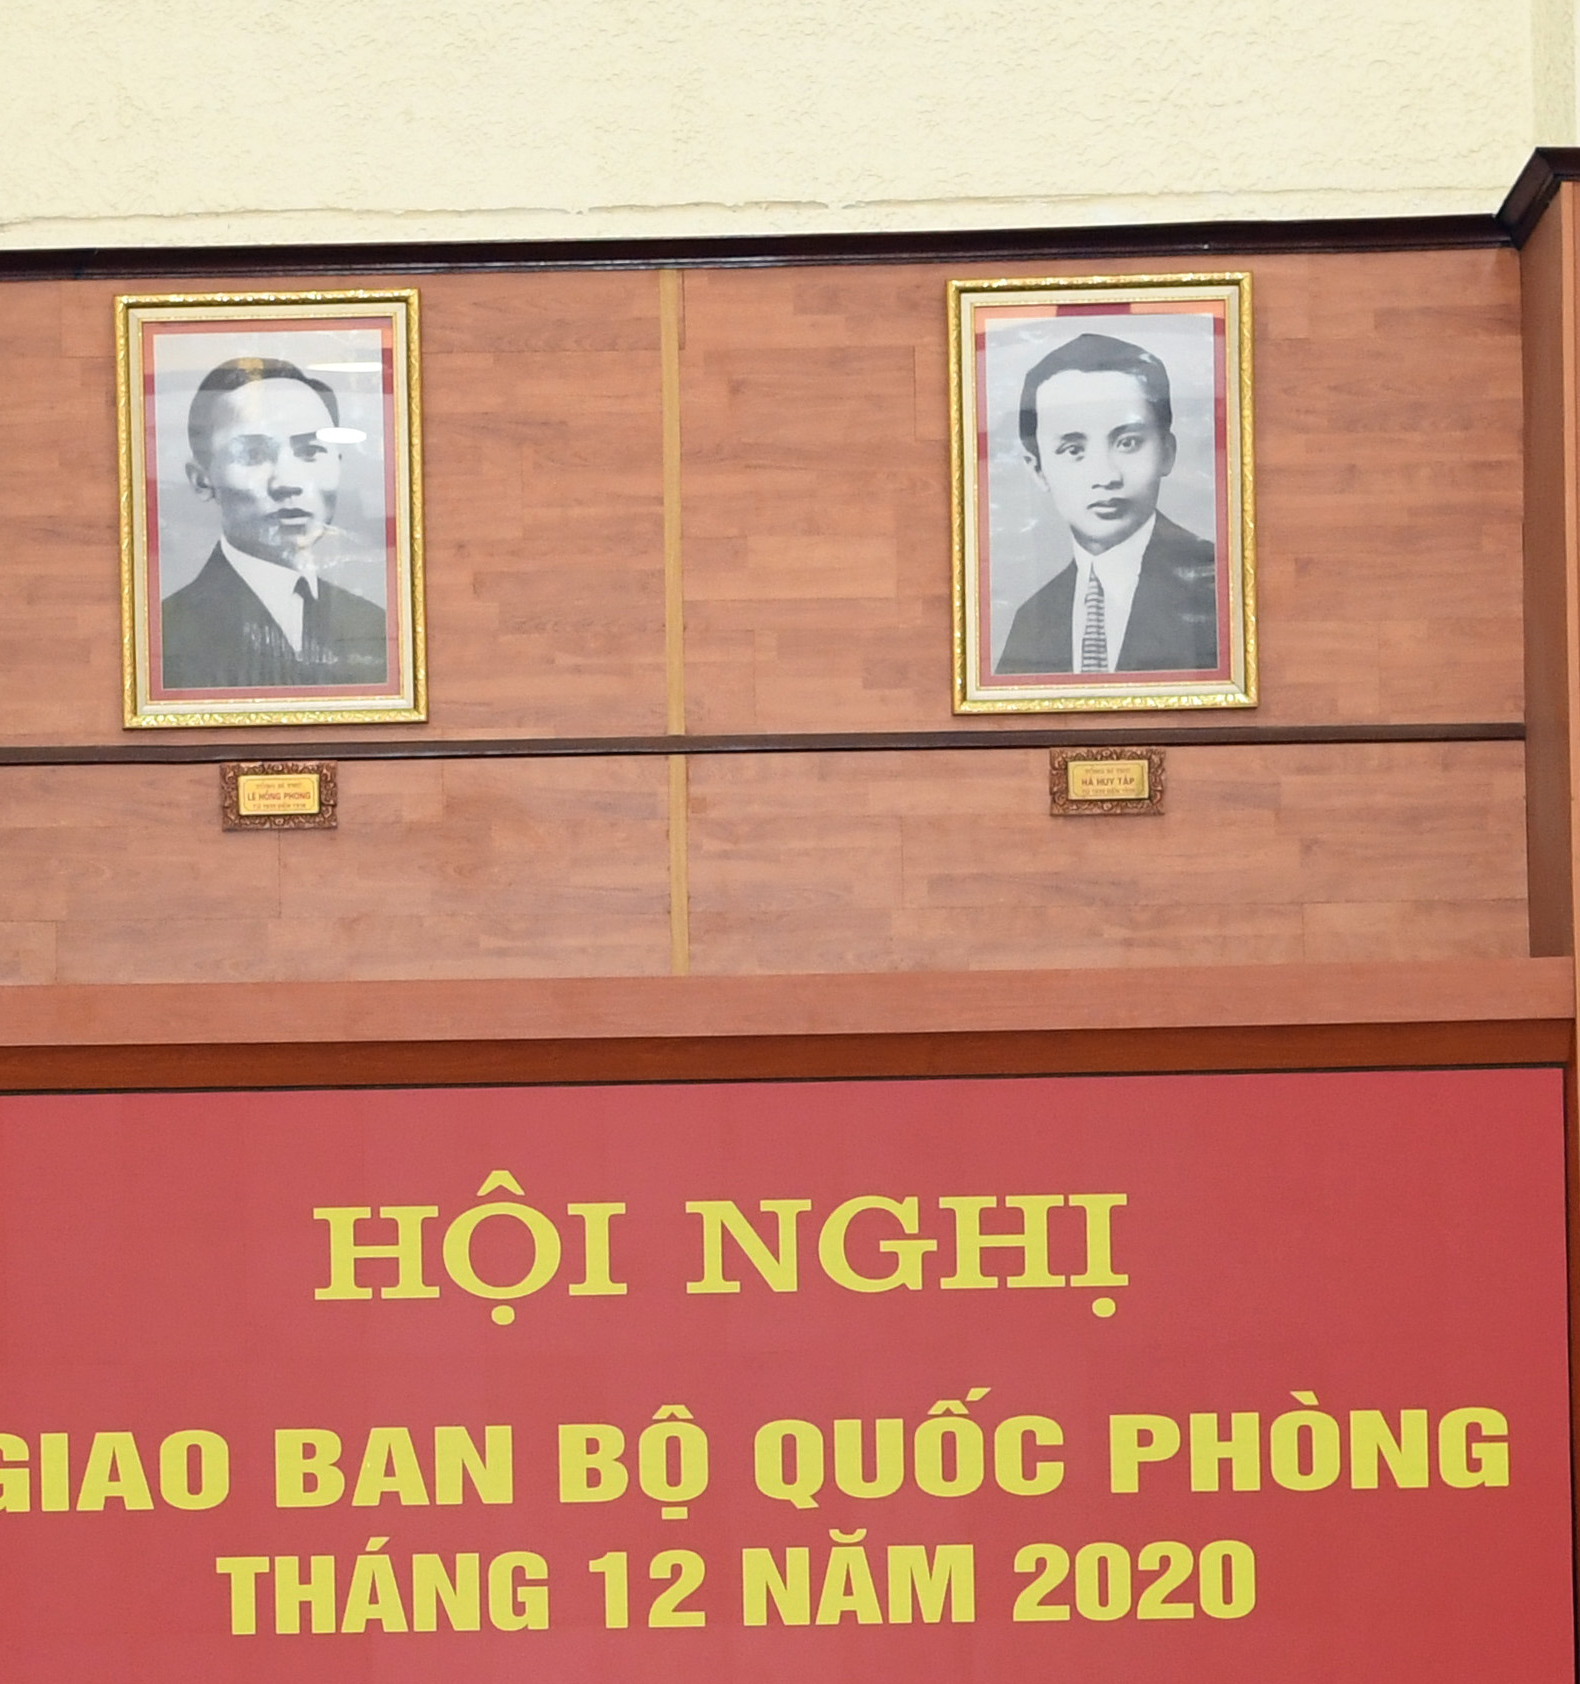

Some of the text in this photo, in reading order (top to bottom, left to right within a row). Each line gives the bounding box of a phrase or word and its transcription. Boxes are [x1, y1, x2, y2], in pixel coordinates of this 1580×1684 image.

[312, 1168, 1130, 1327] HỘI NGHỊ
[273, 1423, 515, 1509] BAN
[556, 1403, 710, 1521] BỘ
[753, 1386, 1066, 1511] QUỐC
[1108, 1390, 1511, 1495] PHÒNG
[214, 1527, 1257, 1637] THÁNG 12 NĂM 2020
